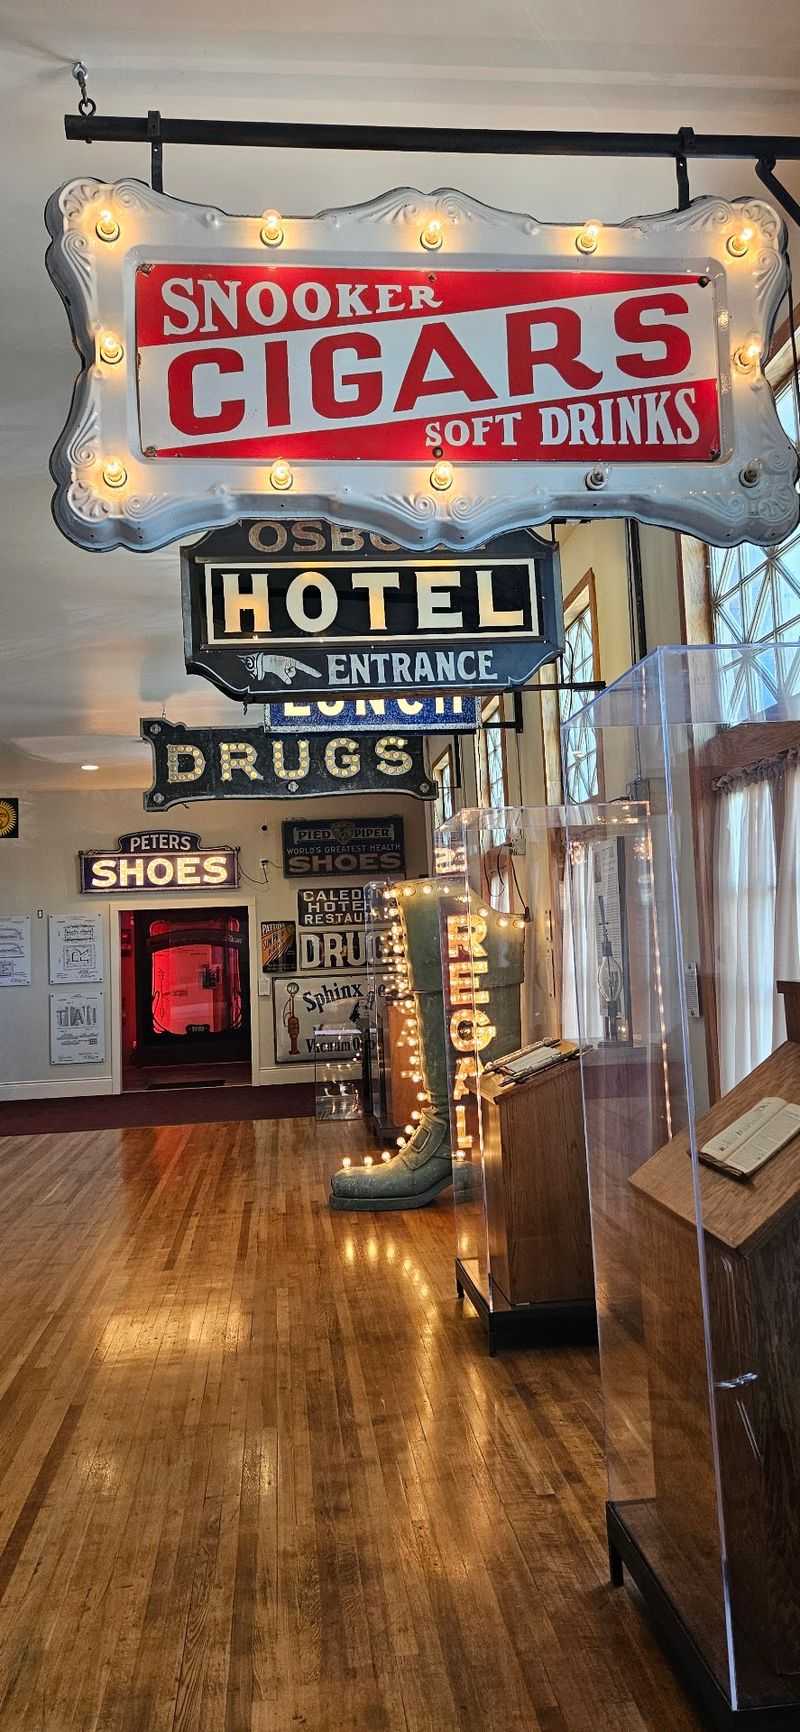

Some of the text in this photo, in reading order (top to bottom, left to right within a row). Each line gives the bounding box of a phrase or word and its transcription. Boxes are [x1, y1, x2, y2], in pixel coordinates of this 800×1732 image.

[161, 277, 444, 337] SNOOKER
[166, 291, 693, 437] CIGARS
[425, 386, 699, 448] SOFT DRINKS
[221, 570, 525, 634] HOTEL
[327, 649, 499, 685] ENTRANCE
[166, 735, 414, 784] DRUGS
[130, 833, 192, 852] PETERS
[298, 828, 390, 840] PIED PIPER
[324, 844, 367, 854] GREATEST
[91, 855, 229, 888] SHOES
[288, 852, 401, 873] SHOES
[307, 901, 364, 913] HOTE
[302, 982, 364, 1014] Sphinx
